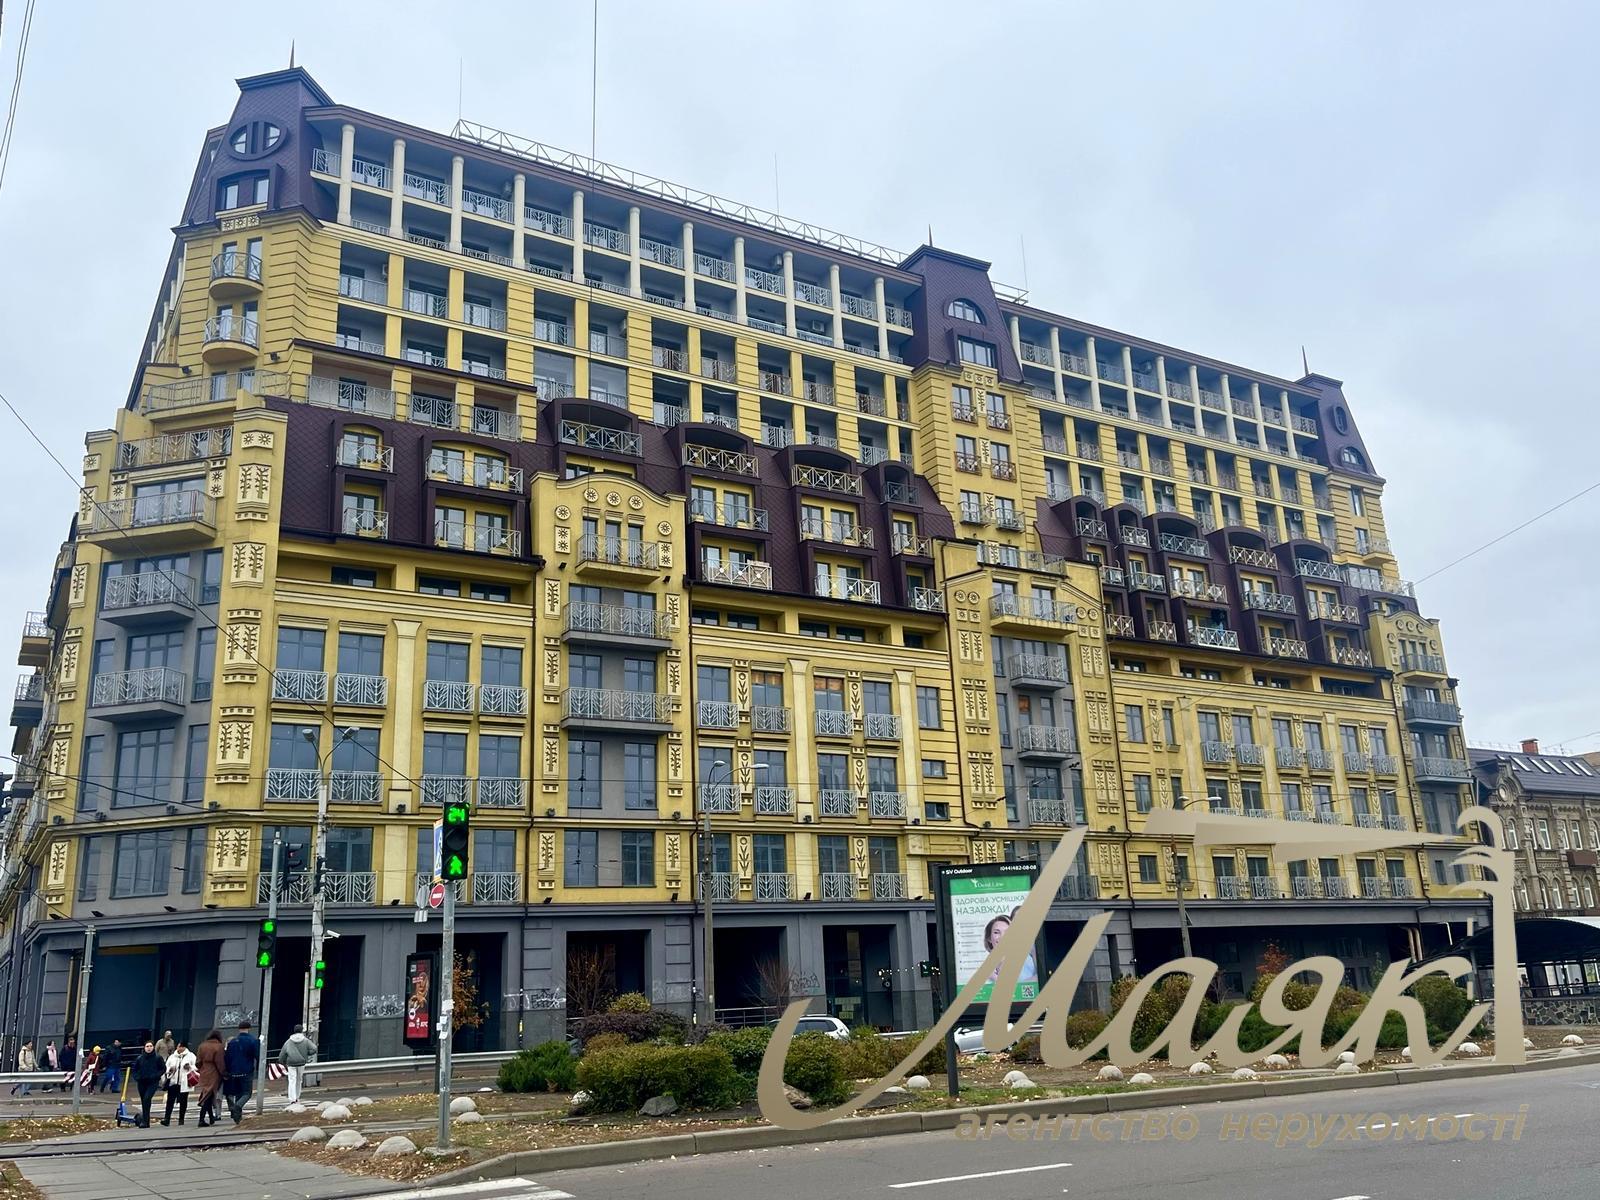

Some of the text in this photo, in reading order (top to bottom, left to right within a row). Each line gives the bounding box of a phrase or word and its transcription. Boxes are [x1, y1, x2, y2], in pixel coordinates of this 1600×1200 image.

[448, 807, 465, 822] 24
[955, 897, 990, 905] ЗДОРОВА
[955, 905, 1010, 915] НАЗАВЖДИ
